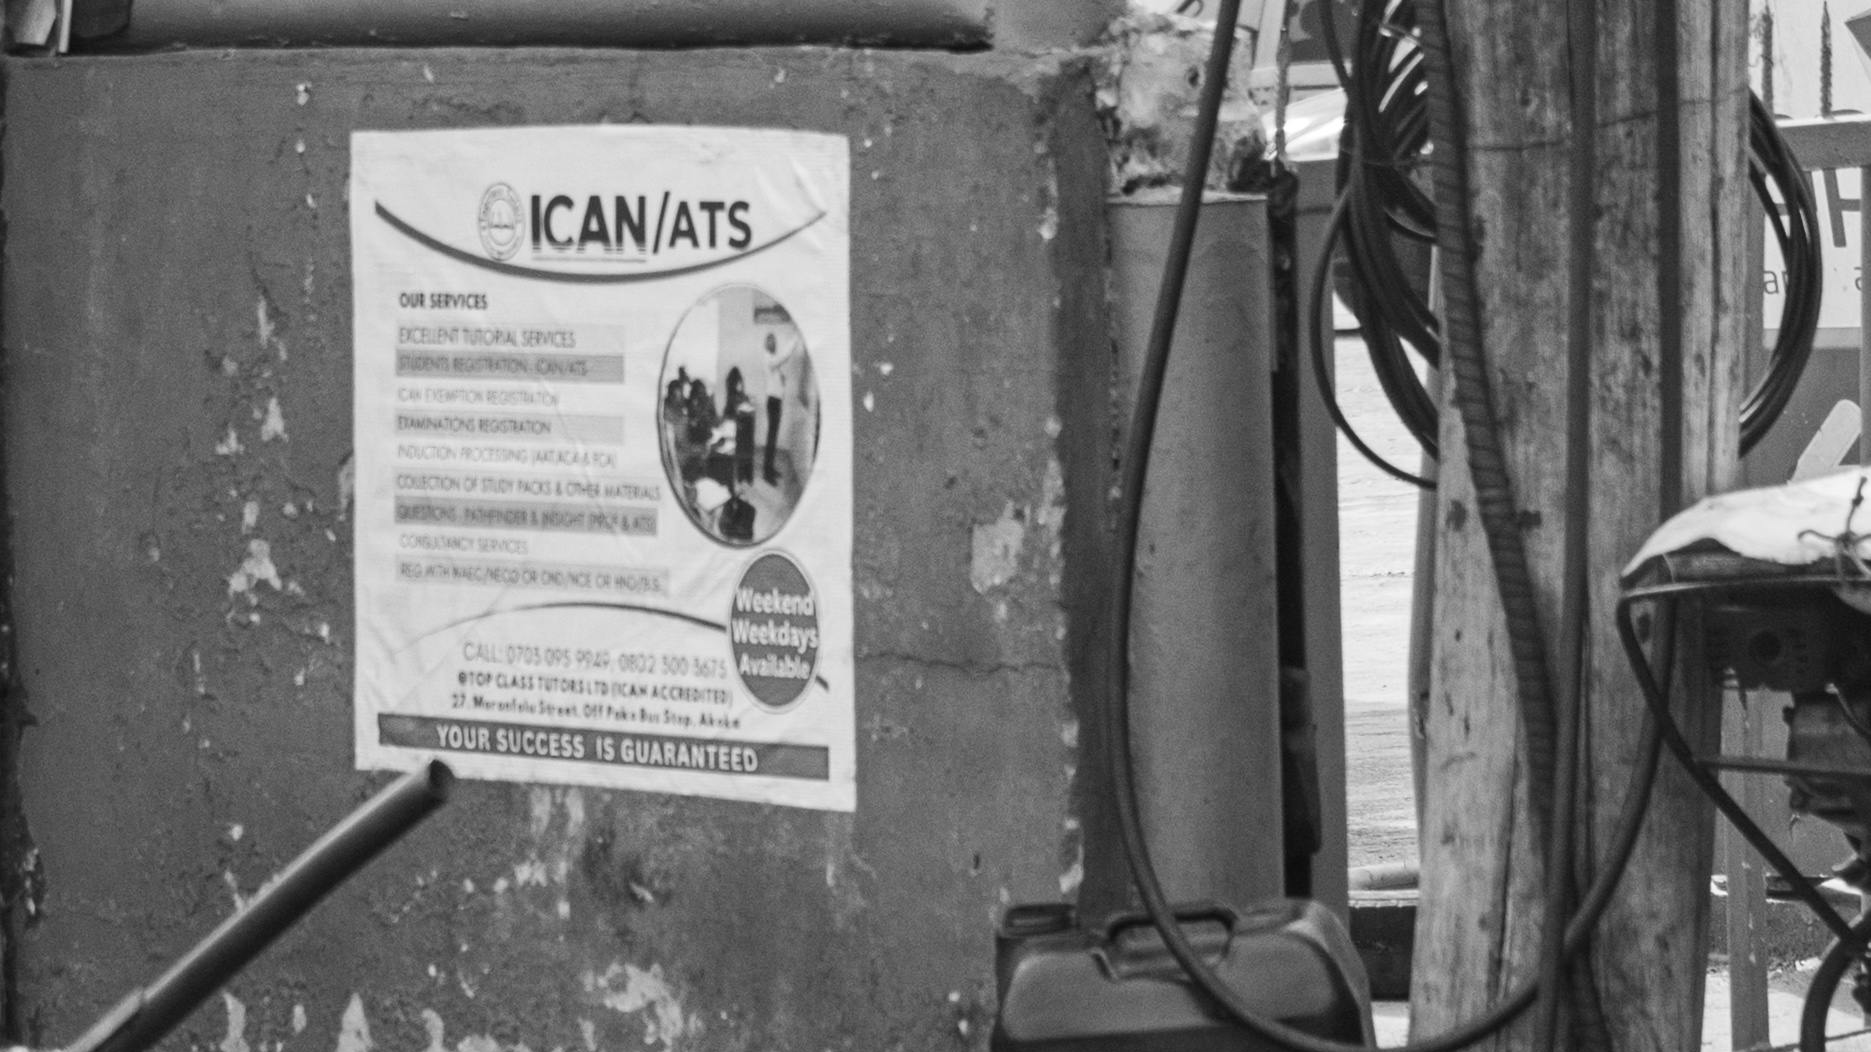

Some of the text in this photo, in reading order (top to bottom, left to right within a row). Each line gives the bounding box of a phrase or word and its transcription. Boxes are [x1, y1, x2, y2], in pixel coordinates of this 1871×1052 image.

[531, 191, 752, 254] ICAN/ATS
[398, 292, 488, 310] OUR SERVICES
[399, 326, 577, 349] EXCELLENT TUTORIAL SERVICES
[399, 354, 450, 372] STUDENTS
[487, 390, 560, 407] REGISTRATION
[479, 417, 552, 435] REGISTRATION
[398, 444, 460, 461] INDUCTION
[462, 446, 528, 464] PROCESSING
[397, 473, 460, 491] COLLECTION
[463, 476, 477, 492] OF
[481, 477, 514, 493] STUDY
[518, 479, 552, 496] PACKS
[566, 481, 600, 498] OTHER
[603, 483, 662, 501] MATERIALS
[399, 533, 528, 554] CONSULTANCY SERVICES
[523, 567, 537, 585] OR
[736, 587, 815, 616] Weekend
[731, 617, 819, 655] Weekdays
[738, 652, 811, 680] Available
[495, 673, 534, 690] CLASS
[537, 675, 585, 695] TUTORS
[587, 679, 609, 696] LTD
[583, 703, 603, 719] Off
[639, 706, 660, 724] Bus
[436, 724, 759, 773] YOUR SUCCESS IS GUARANTEED
